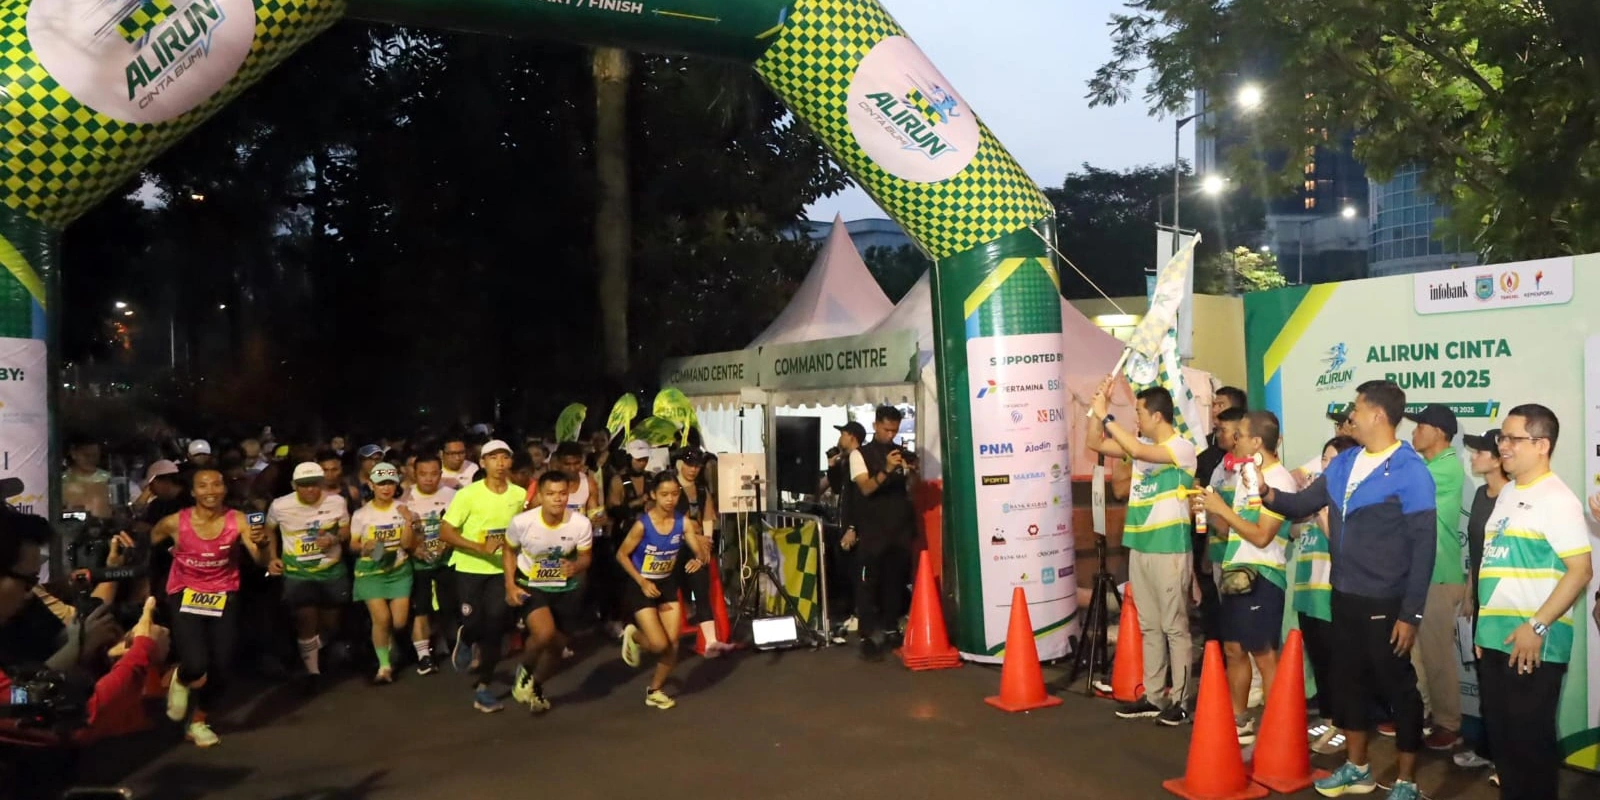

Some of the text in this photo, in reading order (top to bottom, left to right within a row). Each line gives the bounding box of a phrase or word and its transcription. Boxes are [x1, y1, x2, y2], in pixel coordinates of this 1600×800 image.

[126, 0, 220, 101] ALIRUN
[138, 47, 204, 110] CINTA BUMI
[858, 101, 886, 127] CINTA
[865, 92, 947, 156] ALIRUN
[1429, 281, 1469, 301] infobank
[774, 347, 888, 377] COMMAND CENTRE
[1366, 338, 1512, 363] ALIRUN CINTA
[671, 363, 744, 384] COMMAND CENTRE
[1315, 369, 1353, 387] ALIRUN
[1441, 369, 1491, 389] 2025
[979, 442, 1014, 455] PNM
[190, 593, 222, 606] 10047
